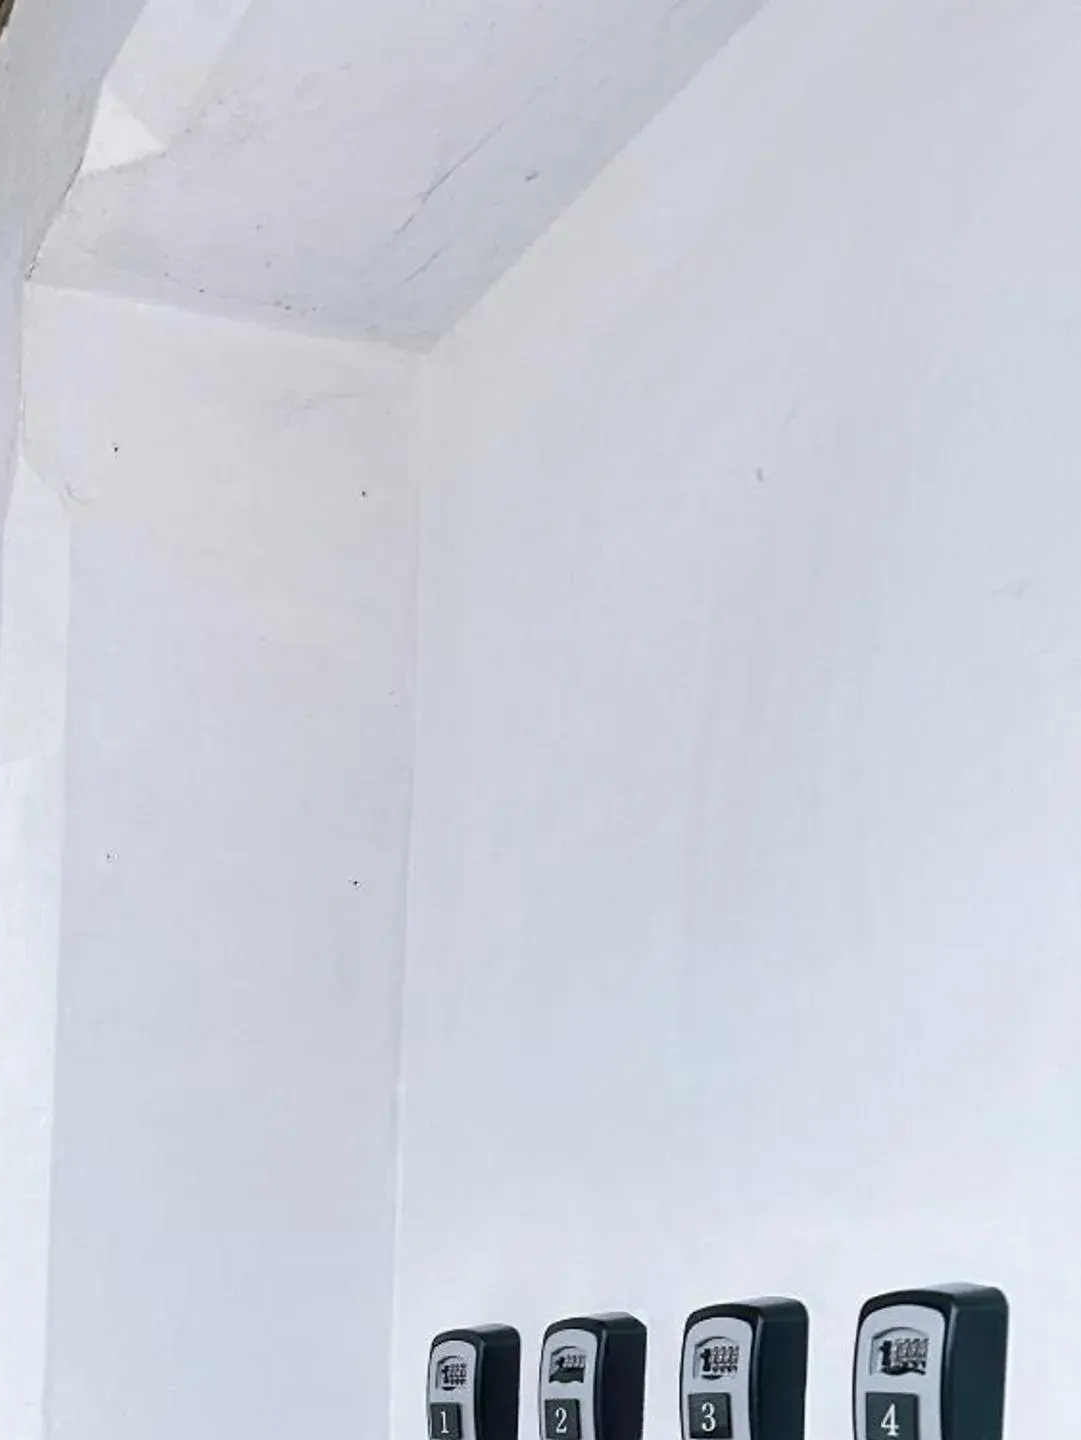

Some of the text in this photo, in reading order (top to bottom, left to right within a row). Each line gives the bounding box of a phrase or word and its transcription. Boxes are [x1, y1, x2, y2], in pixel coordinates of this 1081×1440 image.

[440, 1411, 450, 1434] 1
[555, 1407, 568, 1434] 2
[701, 1402, 716, 1432] 3
[880, 1403, 900, 1437] 4
